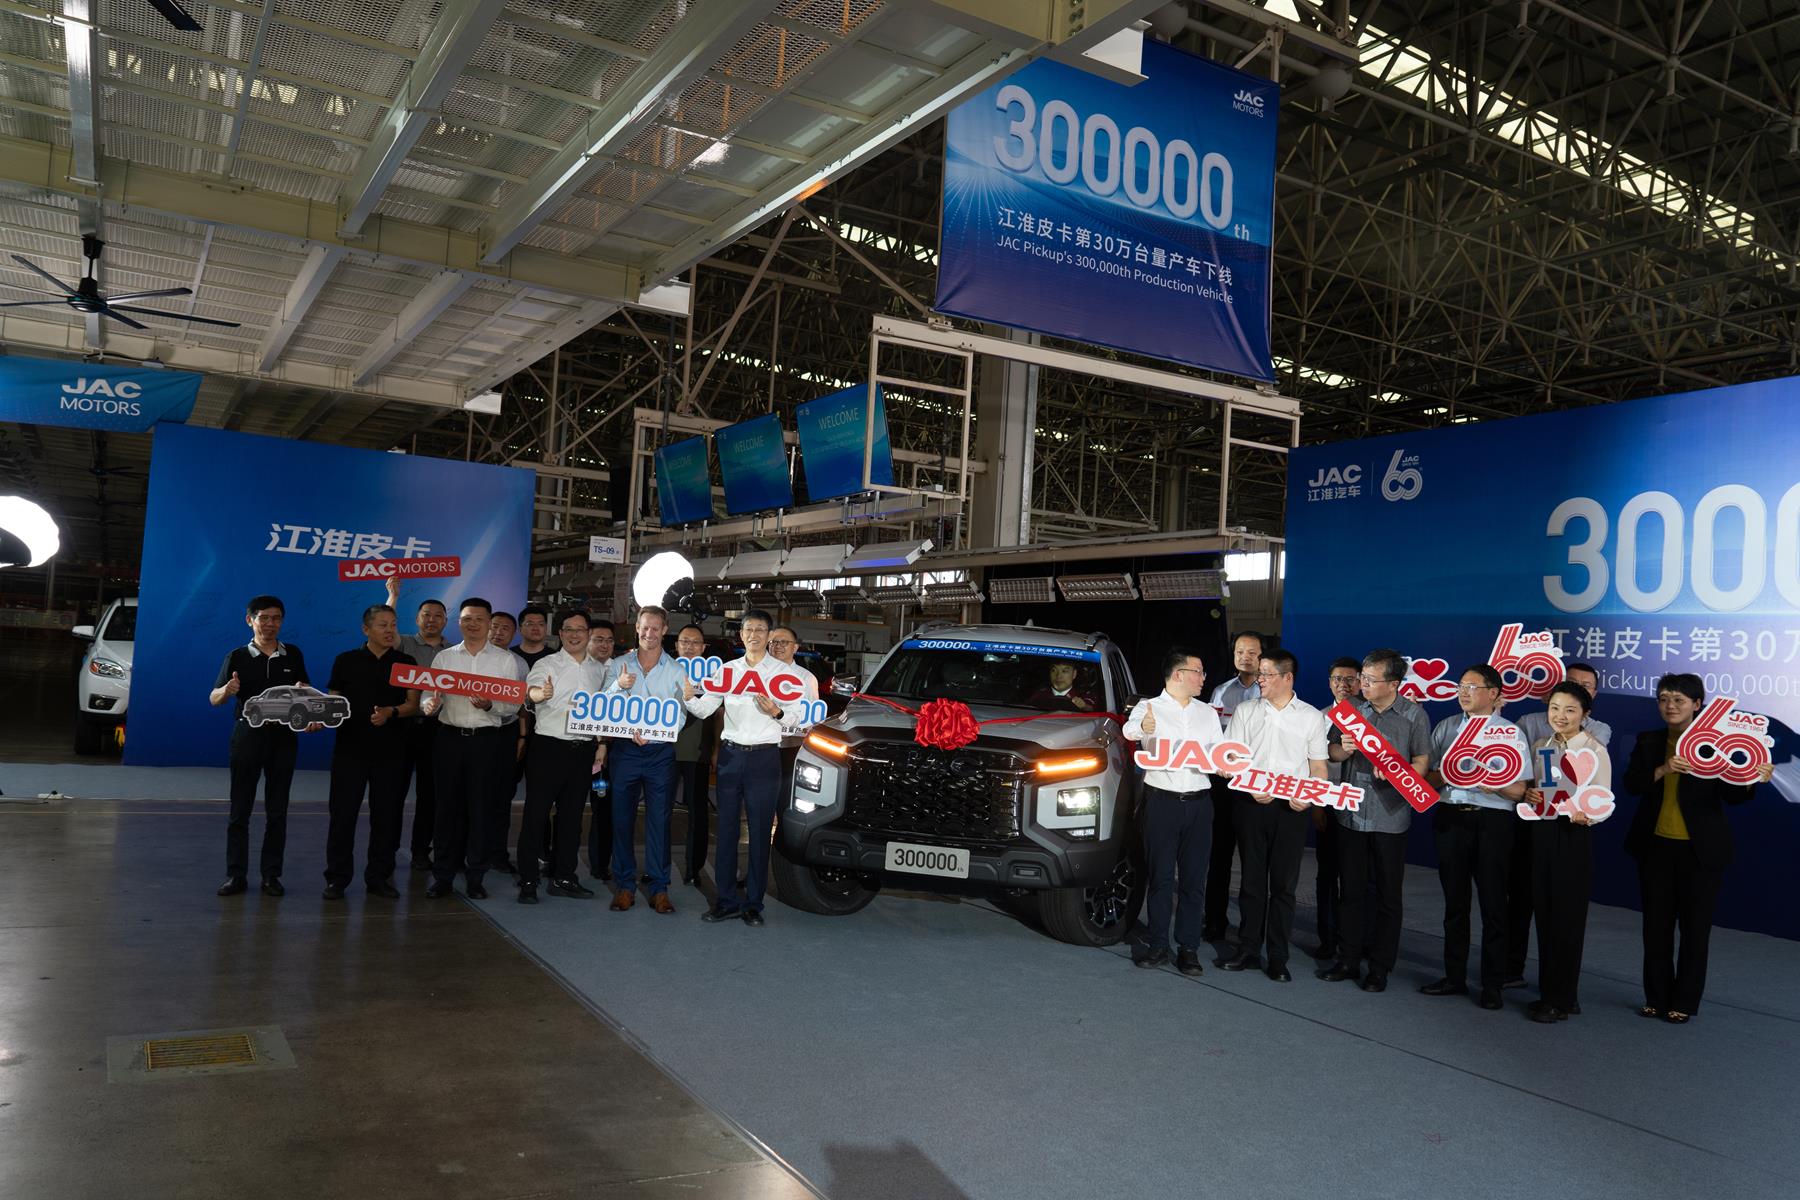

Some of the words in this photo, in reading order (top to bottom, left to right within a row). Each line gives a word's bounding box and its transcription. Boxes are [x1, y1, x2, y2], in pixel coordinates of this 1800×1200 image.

[1233, 100, 1264, 118] MOTORS
[1234, 89, 1264, 107] JAC
[993, 84, 1233, 230] 300000
[1234, 224, 1249, 240] th
[998, 206, 1232, 286] 江淮皮卡第30万台量产车下线
[997, 235, 1020, 251] JAC
[1023, 240, 1073, 264] Pickup's
[1075, 254, 1131, 279] 300,000th
[1134, 269, 1194, 294] Production
[1196, 284, 1233, 304] Vehicle
[61, 377, 142, 399] JAC
[60, 396, 141, 416] MOTORS
[818, 407, 860, 430] WELCOME
[734, 435, 765, 454] WELCOME
[1402, 455, 1420, 463] JAC
[1308, 464, 1362, 487] JAC
[1308, 485, 1361, 502] 江淮汽车
[265, 523, 432, 560] 江淮皮卡
[345, 562, 397, 578] JAC
[399, 561, 456, 574] MOTORS
[918, 640, 971, 650] 300000
[1519, 633, 1550, 645] JAC
[397, 669, 456, 690] JAC
[457, 678, 520, 698] MOTORS
[704, 667, 804, 702] JAC
[1398, 681, 1459, 700] AC
[571, 690, 679, 728] 300000
[1729, 713, 1766, 727] JAC
[1484, 727, 1517, 735] JAC
[1727, 721, 1748, 732] SINCE
[1137, 738, 1251, 773] JAC
[1336, 711, 1382, 753] JAC
[1376, 750, 1430, 803] MOTORS
[1539, 749, 1558, 788] I
[1231, 768, 1362, 809] 江淮皮卡
[1518, 788, 1613, 818] JAC
[894, 848, 958, 871] 300000
